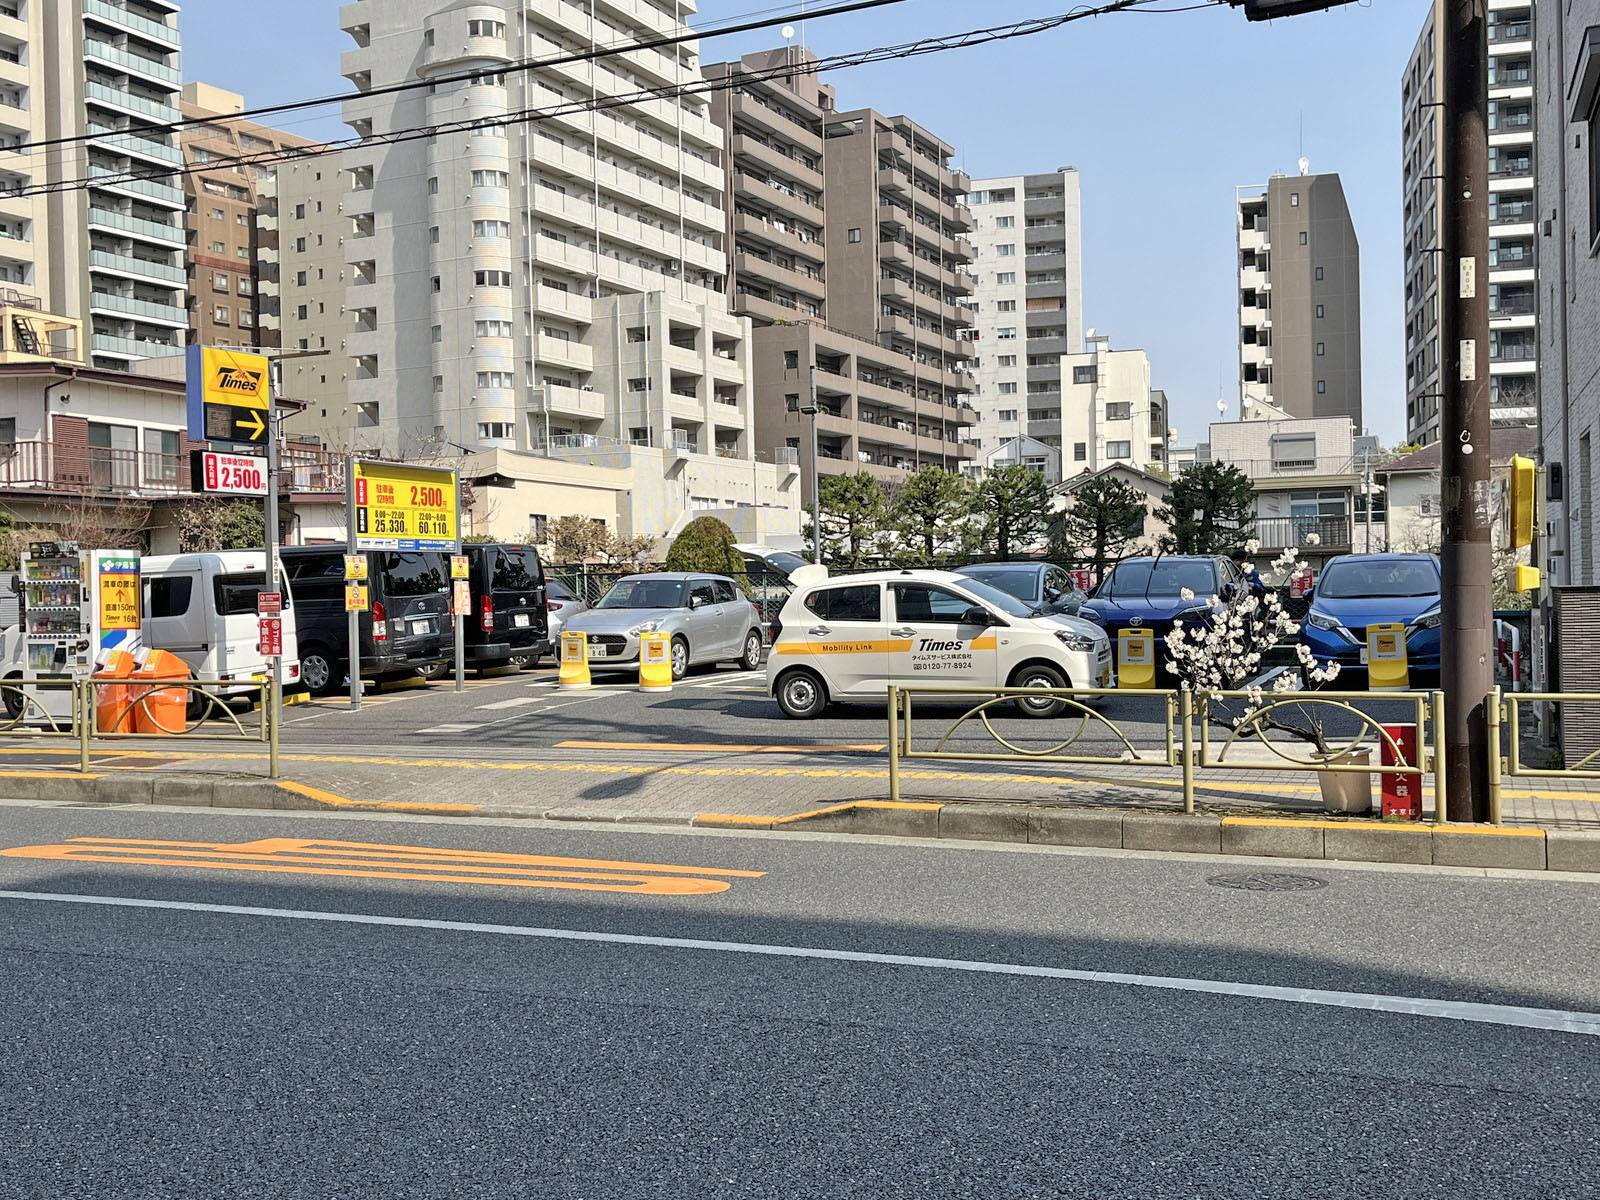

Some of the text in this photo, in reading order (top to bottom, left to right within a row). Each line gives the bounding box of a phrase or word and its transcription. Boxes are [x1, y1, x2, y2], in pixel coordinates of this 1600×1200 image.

[217, 367, 261, 391] Times
[919, 638, 963, 651] Times
[922, 662, 972, 670] 0120-77-8924
